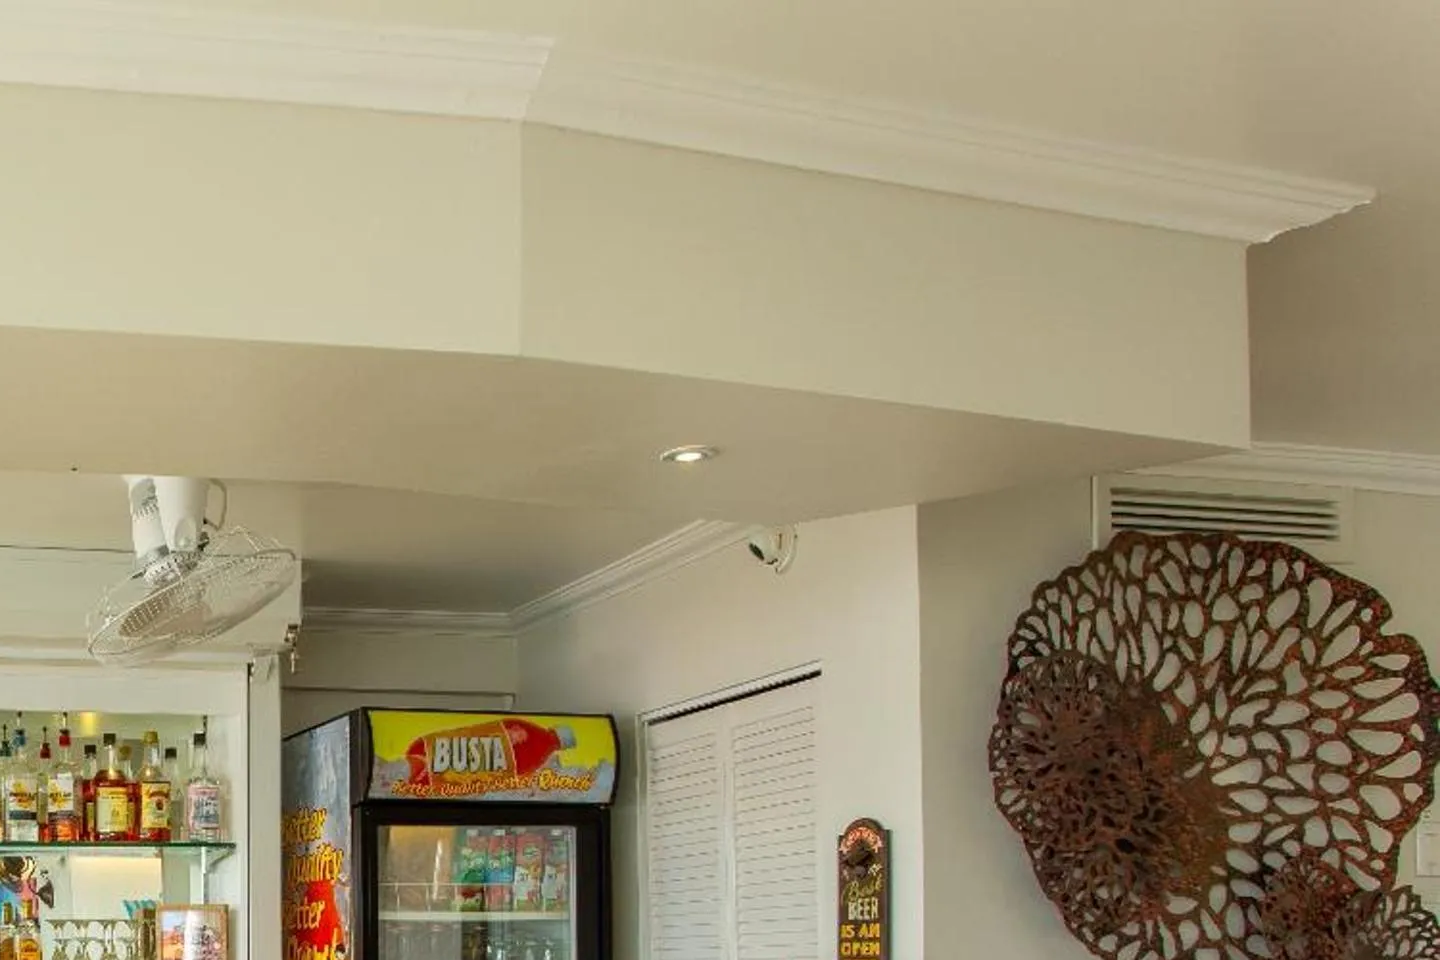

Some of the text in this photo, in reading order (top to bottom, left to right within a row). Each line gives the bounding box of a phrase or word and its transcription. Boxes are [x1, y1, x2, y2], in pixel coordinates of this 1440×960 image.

[433, 736, 508, 773] BUSTA
[847, 898, 879, 921] BEER
[841, 941, 881, 957] OPEN
